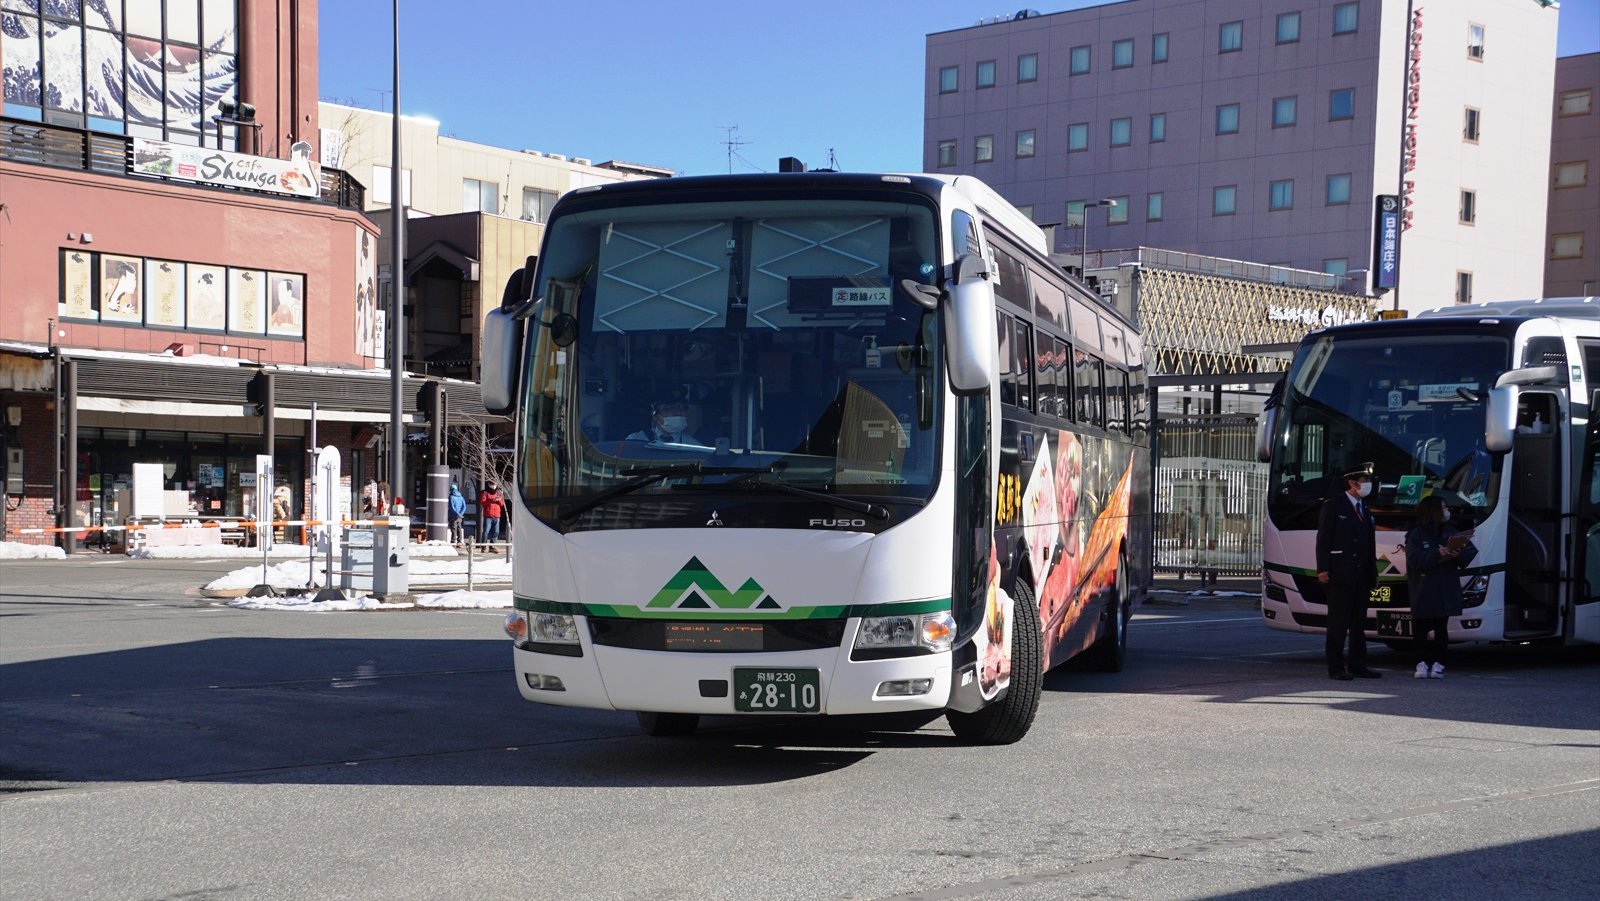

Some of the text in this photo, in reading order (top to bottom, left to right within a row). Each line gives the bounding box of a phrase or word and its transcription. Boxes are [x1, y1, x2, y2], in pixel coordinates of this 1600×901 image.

[1403, 124, 1418, 174] HOTEL
[201, 153, 277, 187] Shunga
[1401, 181, 1416, 234] PLAZA
[849, 292, 887, 301] 路線バス
[1407, 483, 1417, 496] 3
[809, 518, 866, 527] FUSO
[749, 683, 816, 708] 28-10
